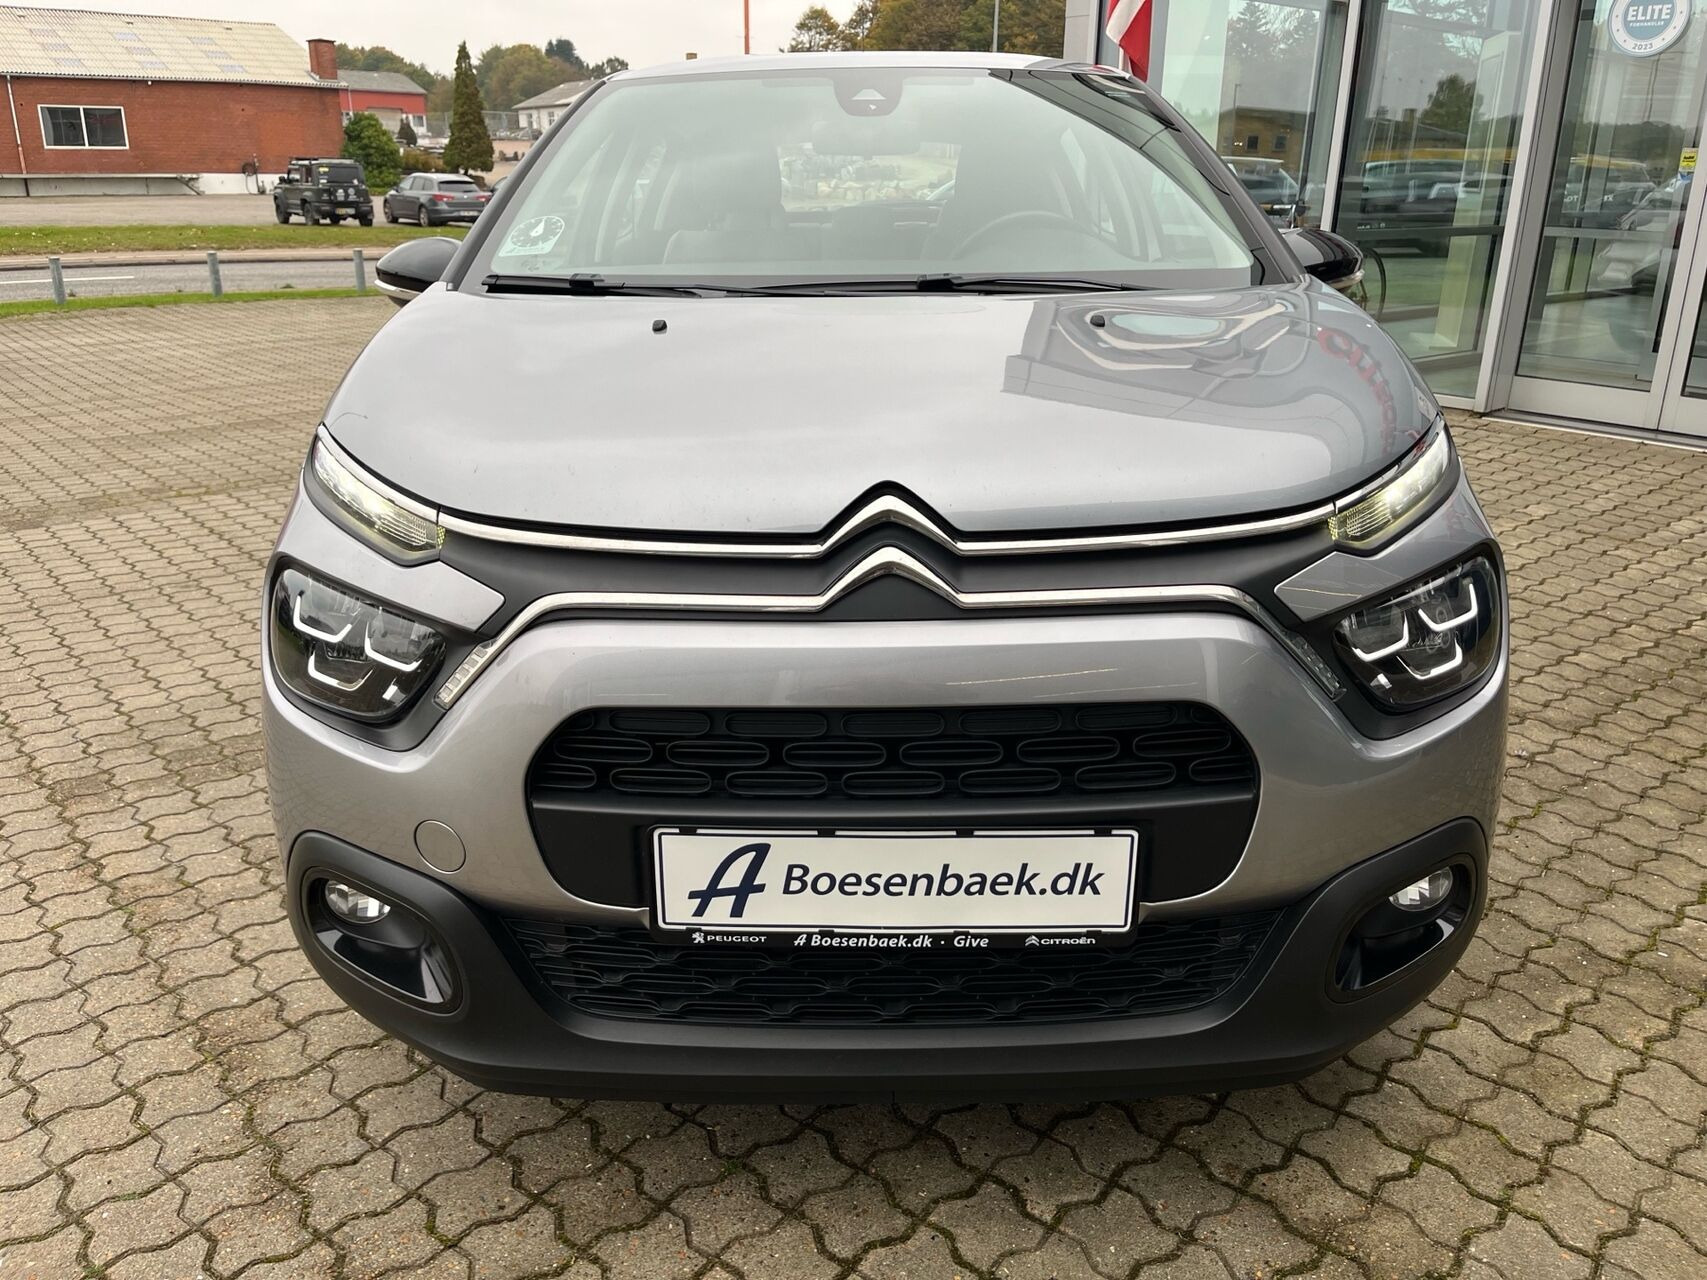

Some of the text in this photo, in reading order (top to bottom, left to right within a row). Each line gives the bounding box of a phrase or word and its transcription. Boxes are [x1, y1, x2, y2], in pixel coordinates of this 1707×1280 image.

[1627, 4, 1672, 21] ELITE
[1632, 42, 1653, 51] 2023
[782, 862, 1105, 897] Boesenbaek.dk
[706, 934, 767, 943] PEUGEOT
[810, 934, 933, 948] Boesenbaek.dk
[953, 935, 990, 948] Give
